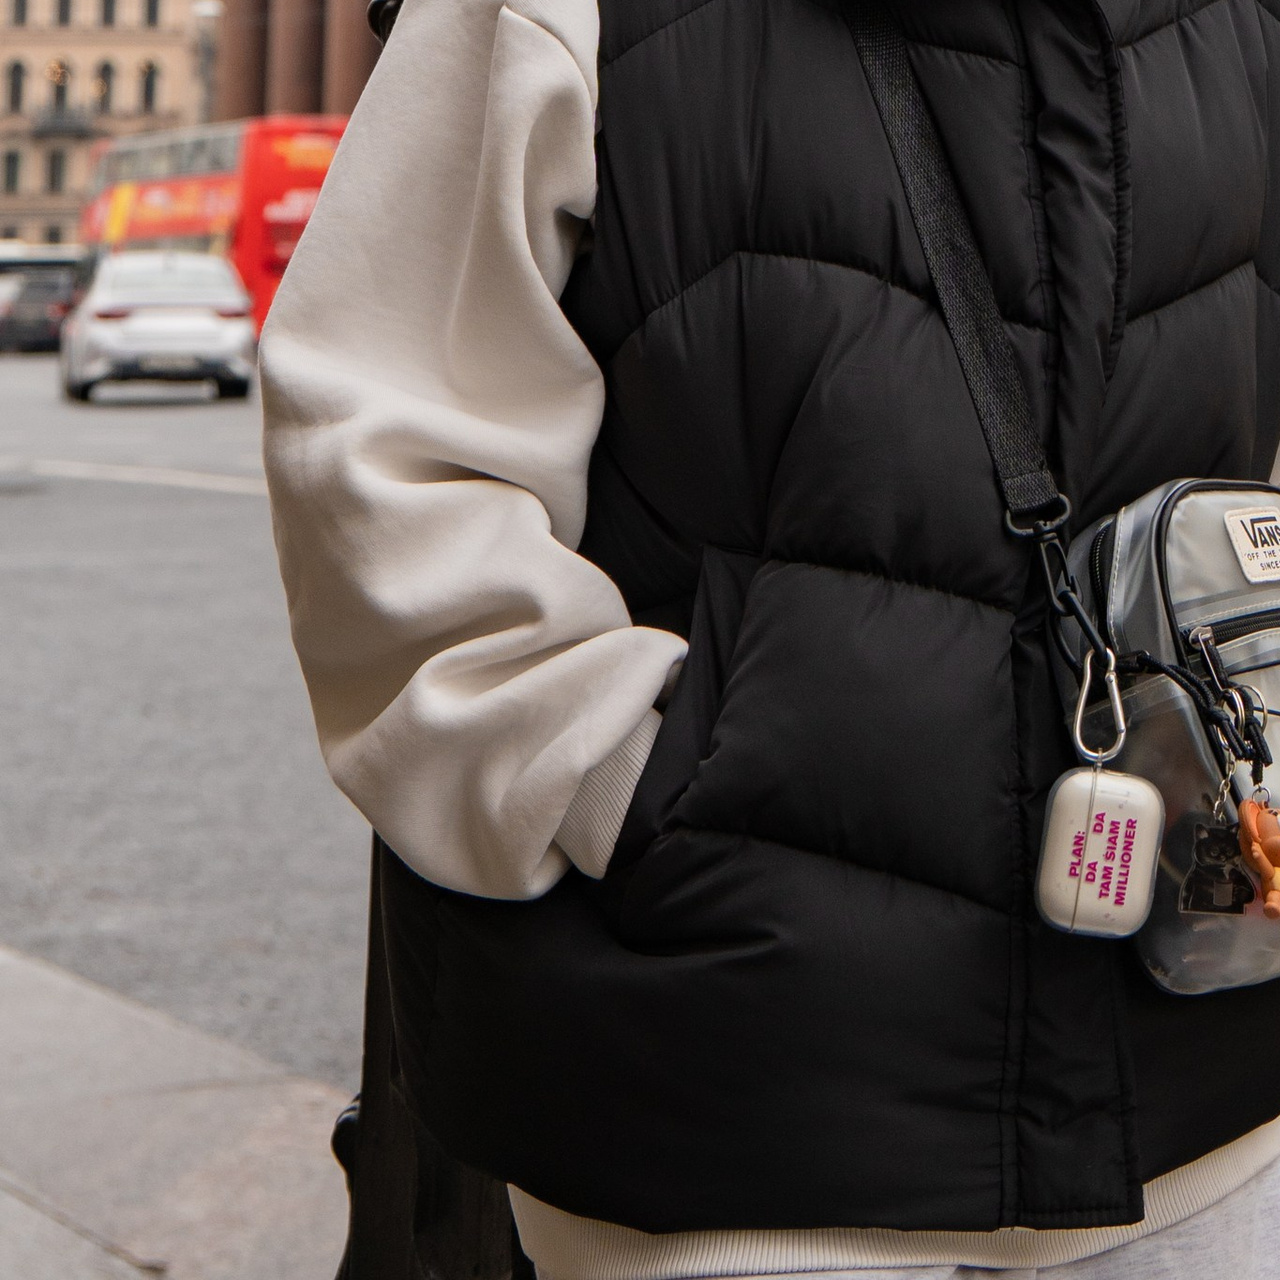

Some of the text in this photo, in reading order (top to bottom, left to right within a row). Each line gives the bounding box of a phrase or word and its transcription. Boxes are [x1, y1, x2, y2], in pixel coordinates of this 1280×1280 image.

[1263, 549, 1277, 559] THE
[1069, 830, 1086, 877] PLAN:
[1085, 812, 1106, 883] DA DA
[1114, 818, 1137, 906] MILLIONER
[1098, 865, 1113, 899] TAM
